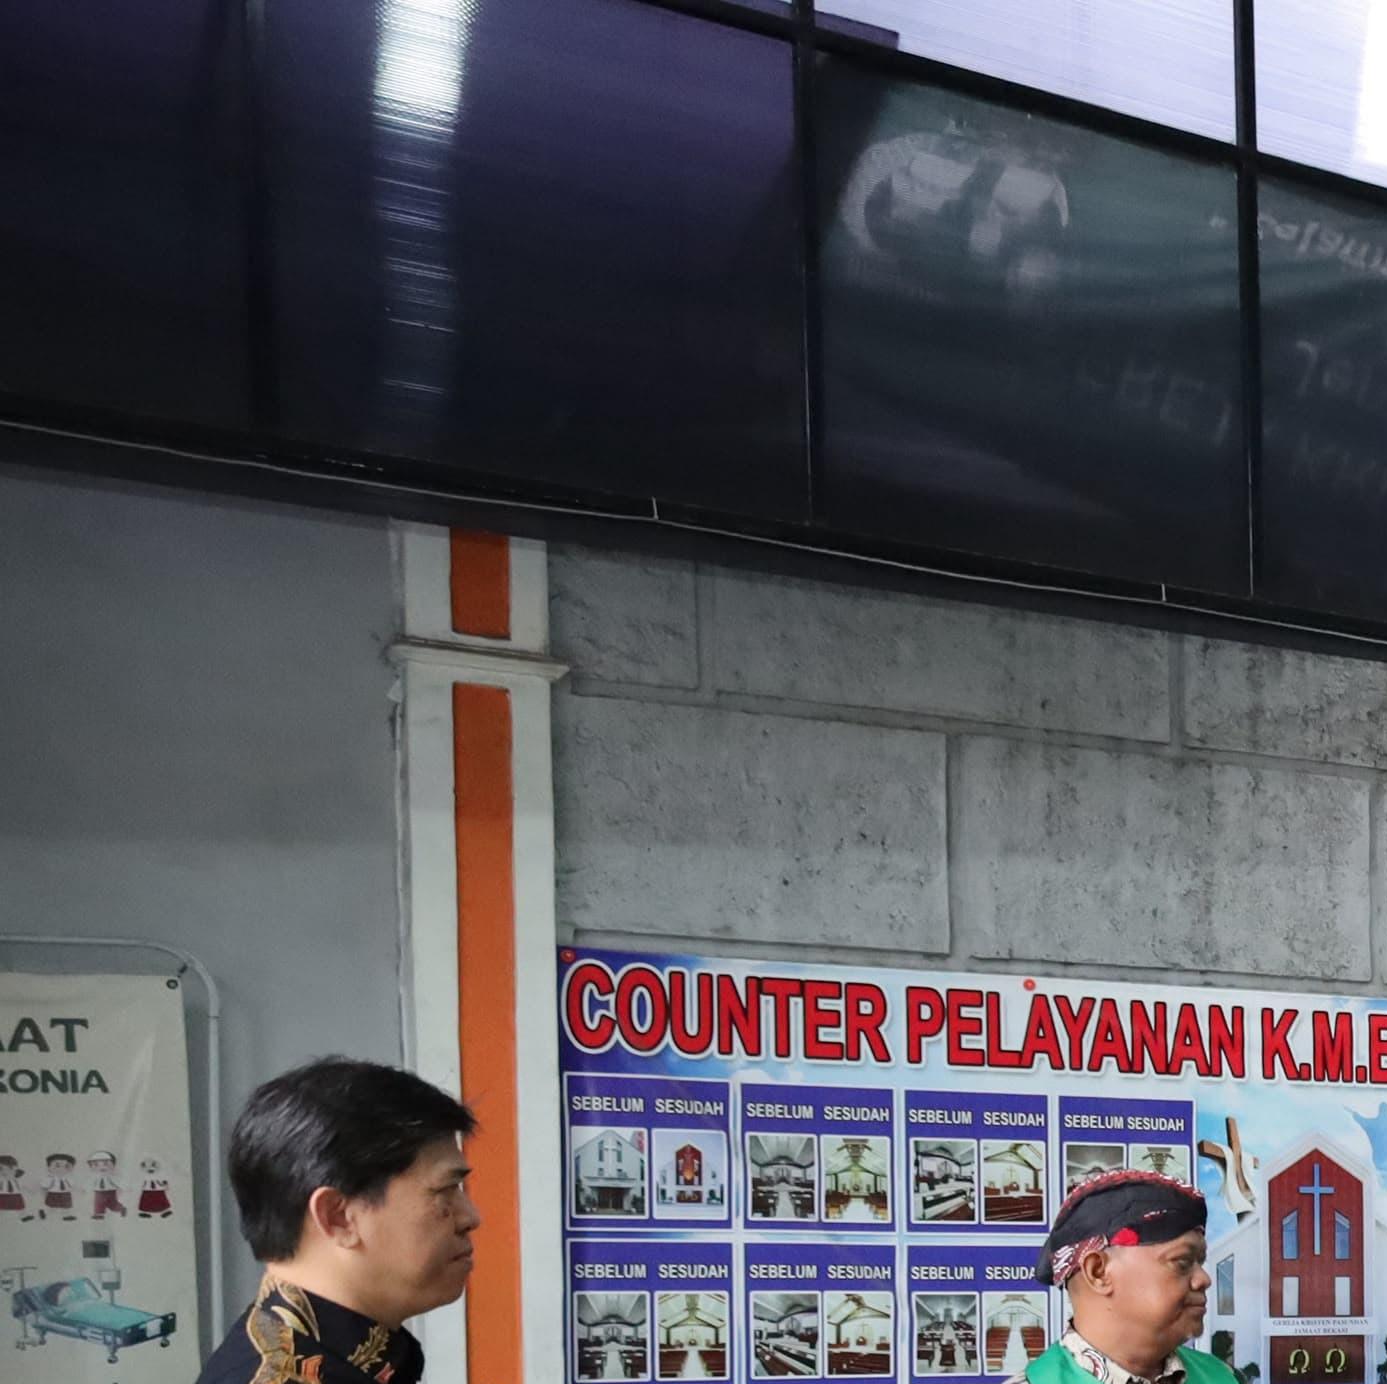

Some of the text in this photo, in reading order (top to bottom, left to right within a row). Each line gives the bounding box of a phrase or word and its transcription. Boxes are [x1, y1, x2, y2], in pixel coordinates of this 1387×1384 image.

[567, 964, 891, 1063] COUNTER
[906, 986, 1247, 1078] PELAYANAN
[0, 1016, 89, 1053] AT
[572, 1096, 724, 1115] SEBELUM SESUDAH
[746, 1103, 890, 1122] SEBELUM SESUDAH
[908, 1108, 1045, 1127] SEBELUM SESUDAH
[1064, 1114, 1185, 1132] SEBELUM SESUDAH
[575, 1263, 729, 1279] SEBELUM SESUDAH
[749, 1264, 891, 1280] SEBELUM SESUDAH
[911, 1266, 1036, 1280] SEBELUM SESUDA
